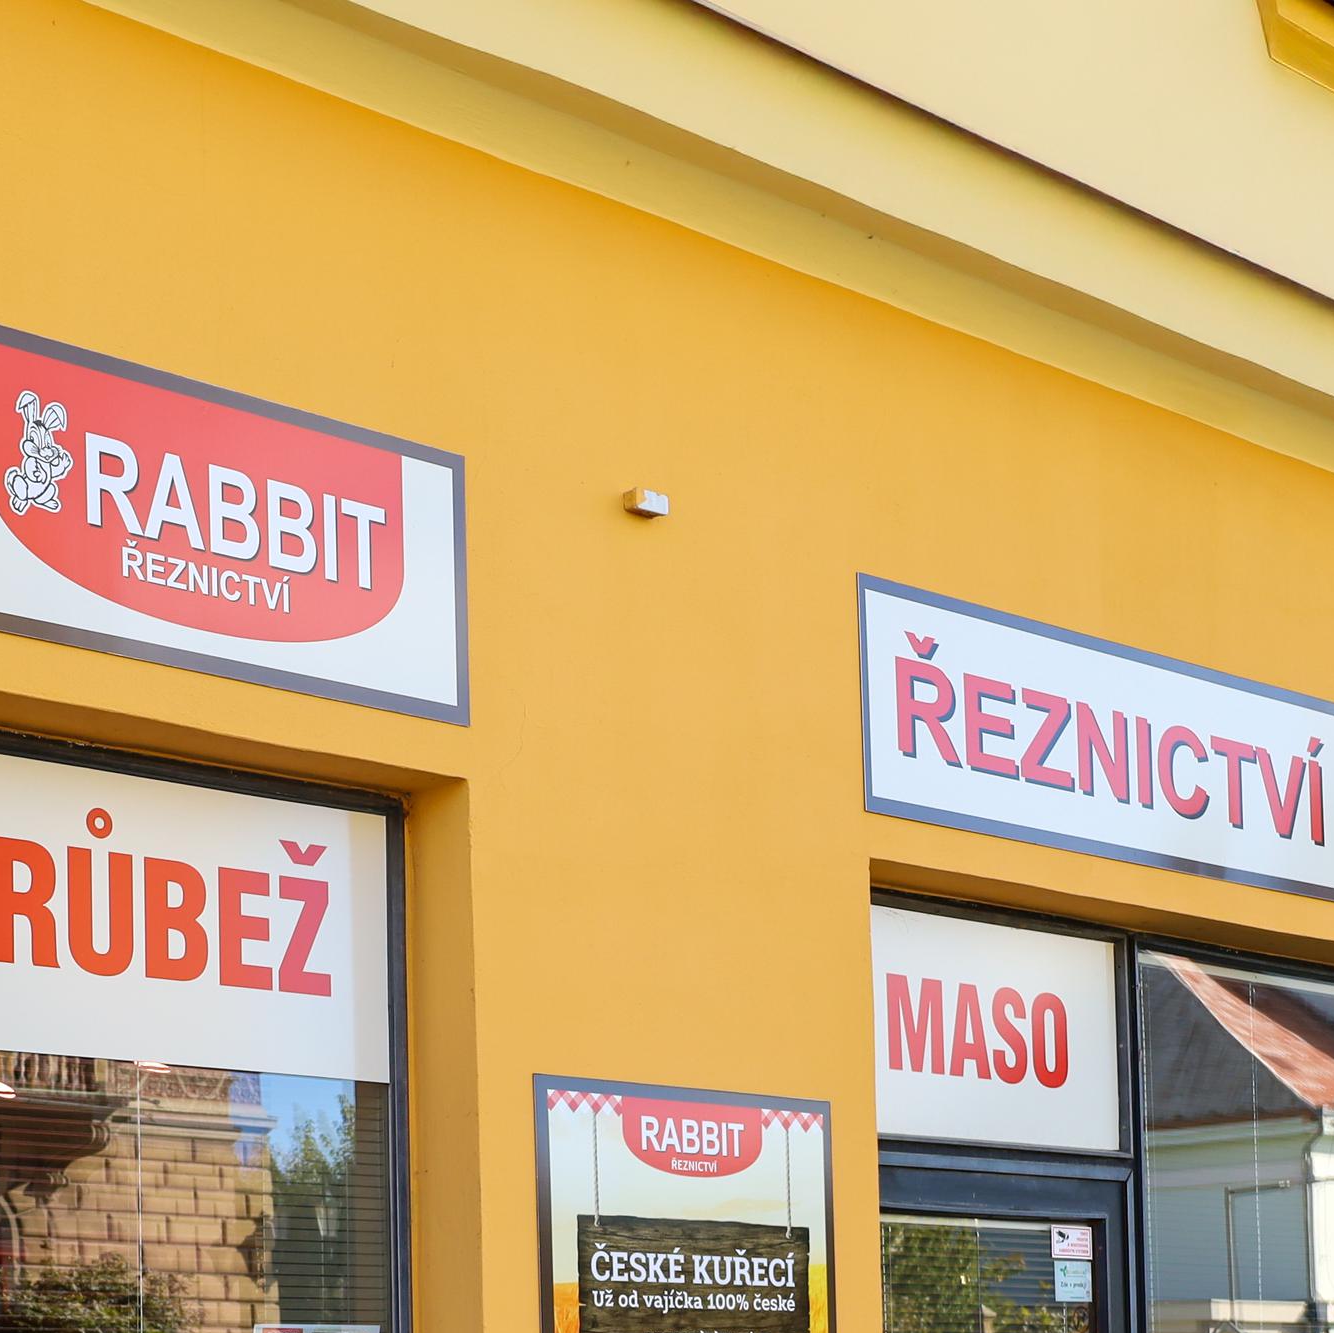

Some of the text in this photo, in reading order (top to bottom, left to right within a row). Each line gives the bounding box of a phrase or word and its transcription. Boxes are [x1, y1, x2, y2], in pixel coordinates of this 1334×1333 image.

[85, 432, 387, 590] RABBIT
[121, 538, 291, 614] ŘEZNICTVÍ
[896, 631, 1325, 847] ŘEZNICTVÍ
[886, 972, 1069, 1088] MASO
[640, 1115, 744, 1157] RABBIT
[671, 1157, 717, 1173] ŘEZNICTVÍ
[591, 1243, 795, 1288] ČESKÉ KUŘECÍ
[592, 1290, 795, 1314] Už od vajíčka 100% české
